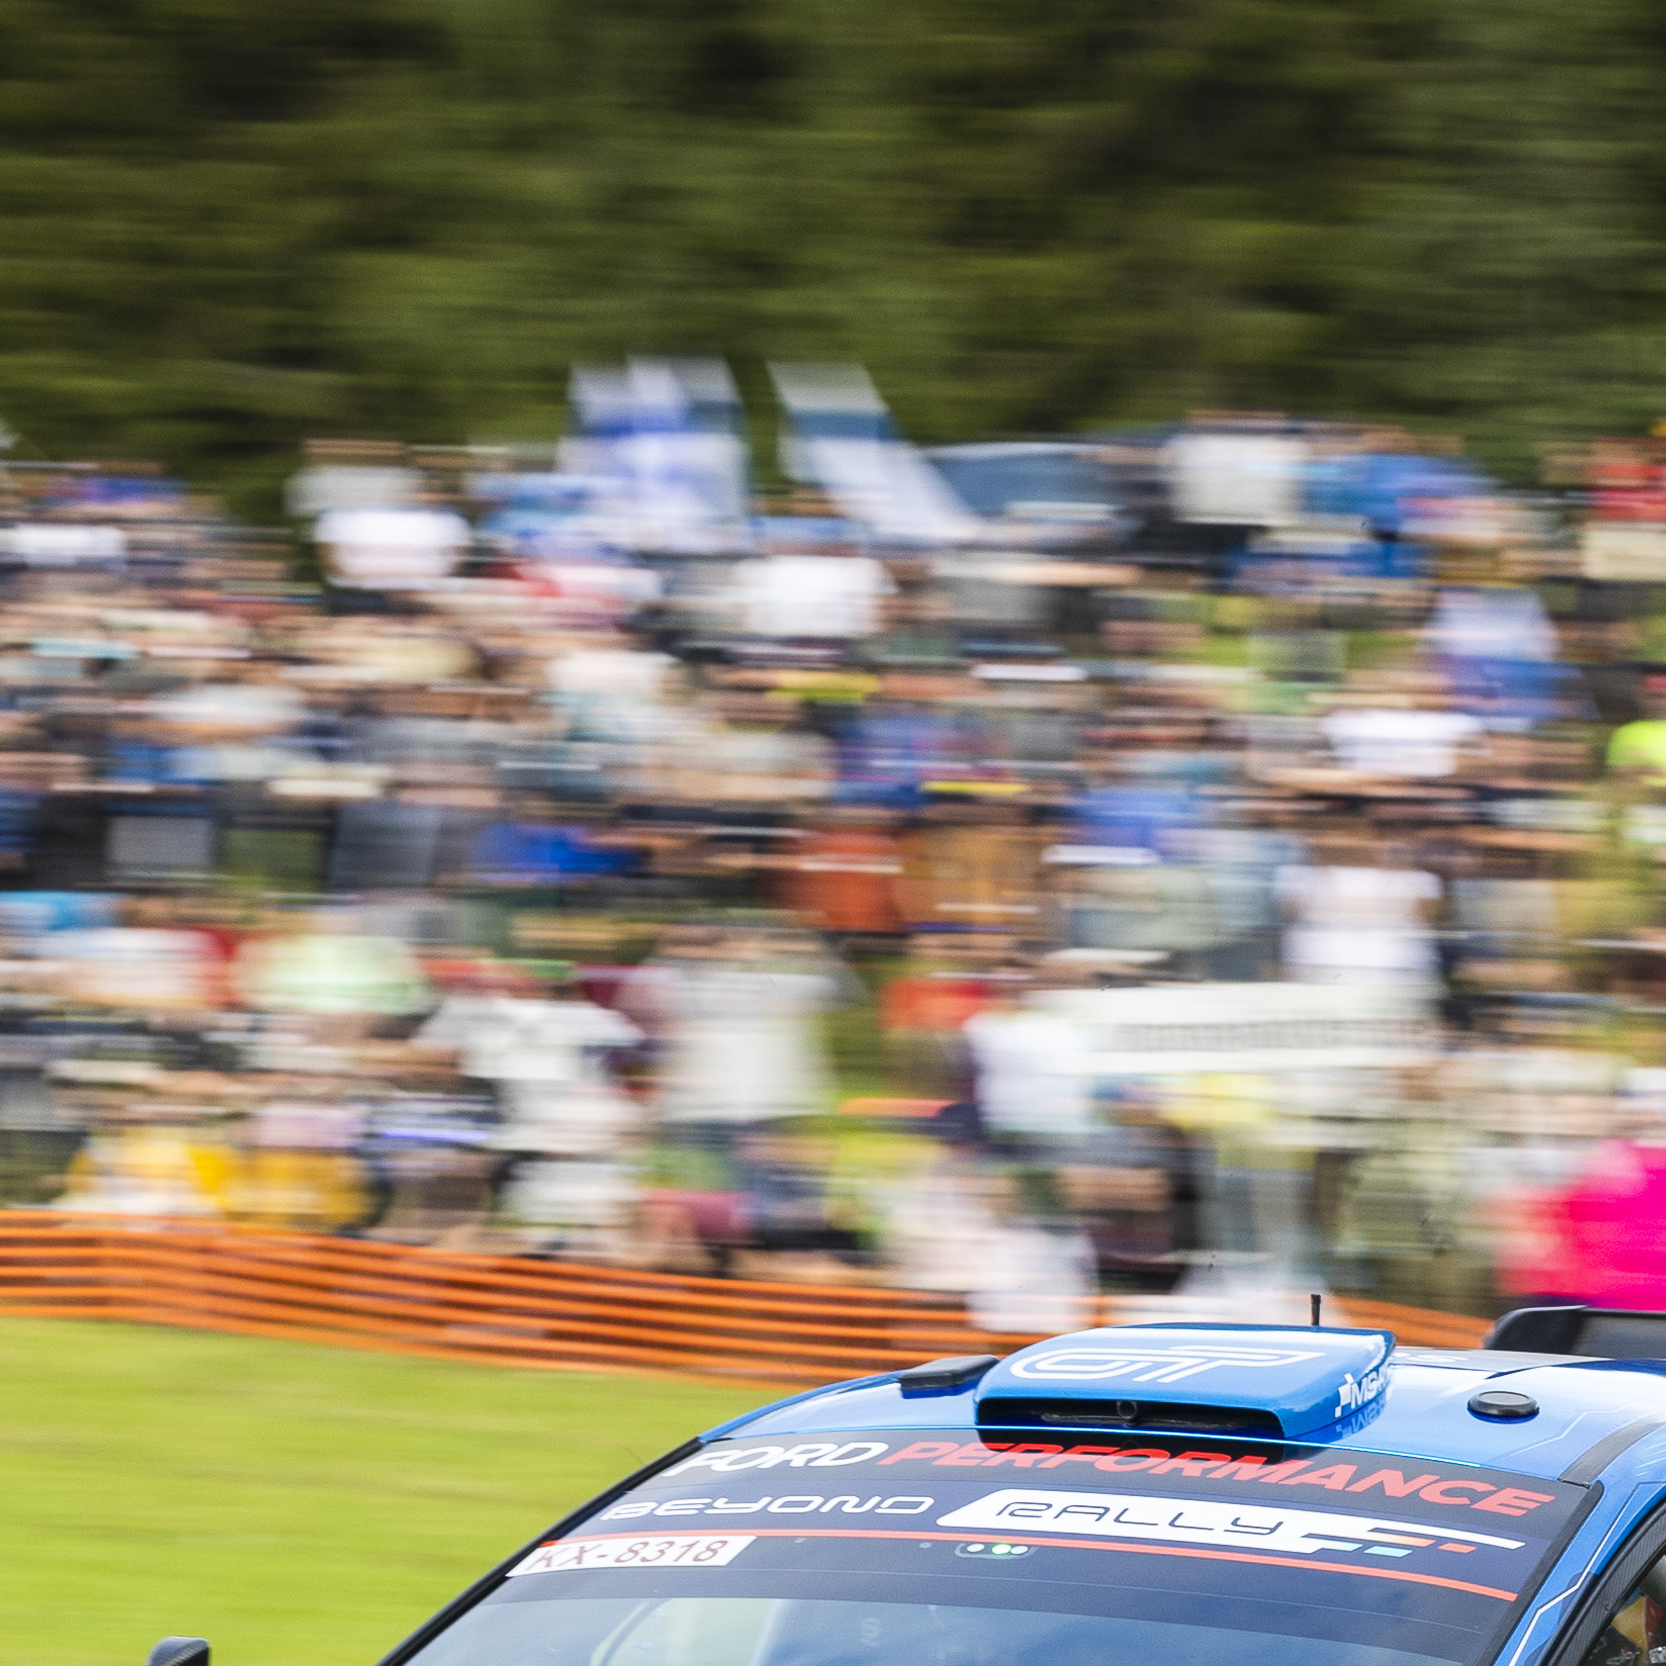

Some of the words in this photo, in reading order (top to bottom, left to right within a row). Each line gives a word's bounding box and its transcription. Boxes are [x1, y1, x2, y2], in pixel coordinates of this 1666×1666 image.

[661, 1441, 889, 1478] FORD
[878, 1440, 1556, 1518] PERFORMANCE
[599, 1495, 934, 1521] BEYOND
[996, 1501, 1285, 1536] RALLY
